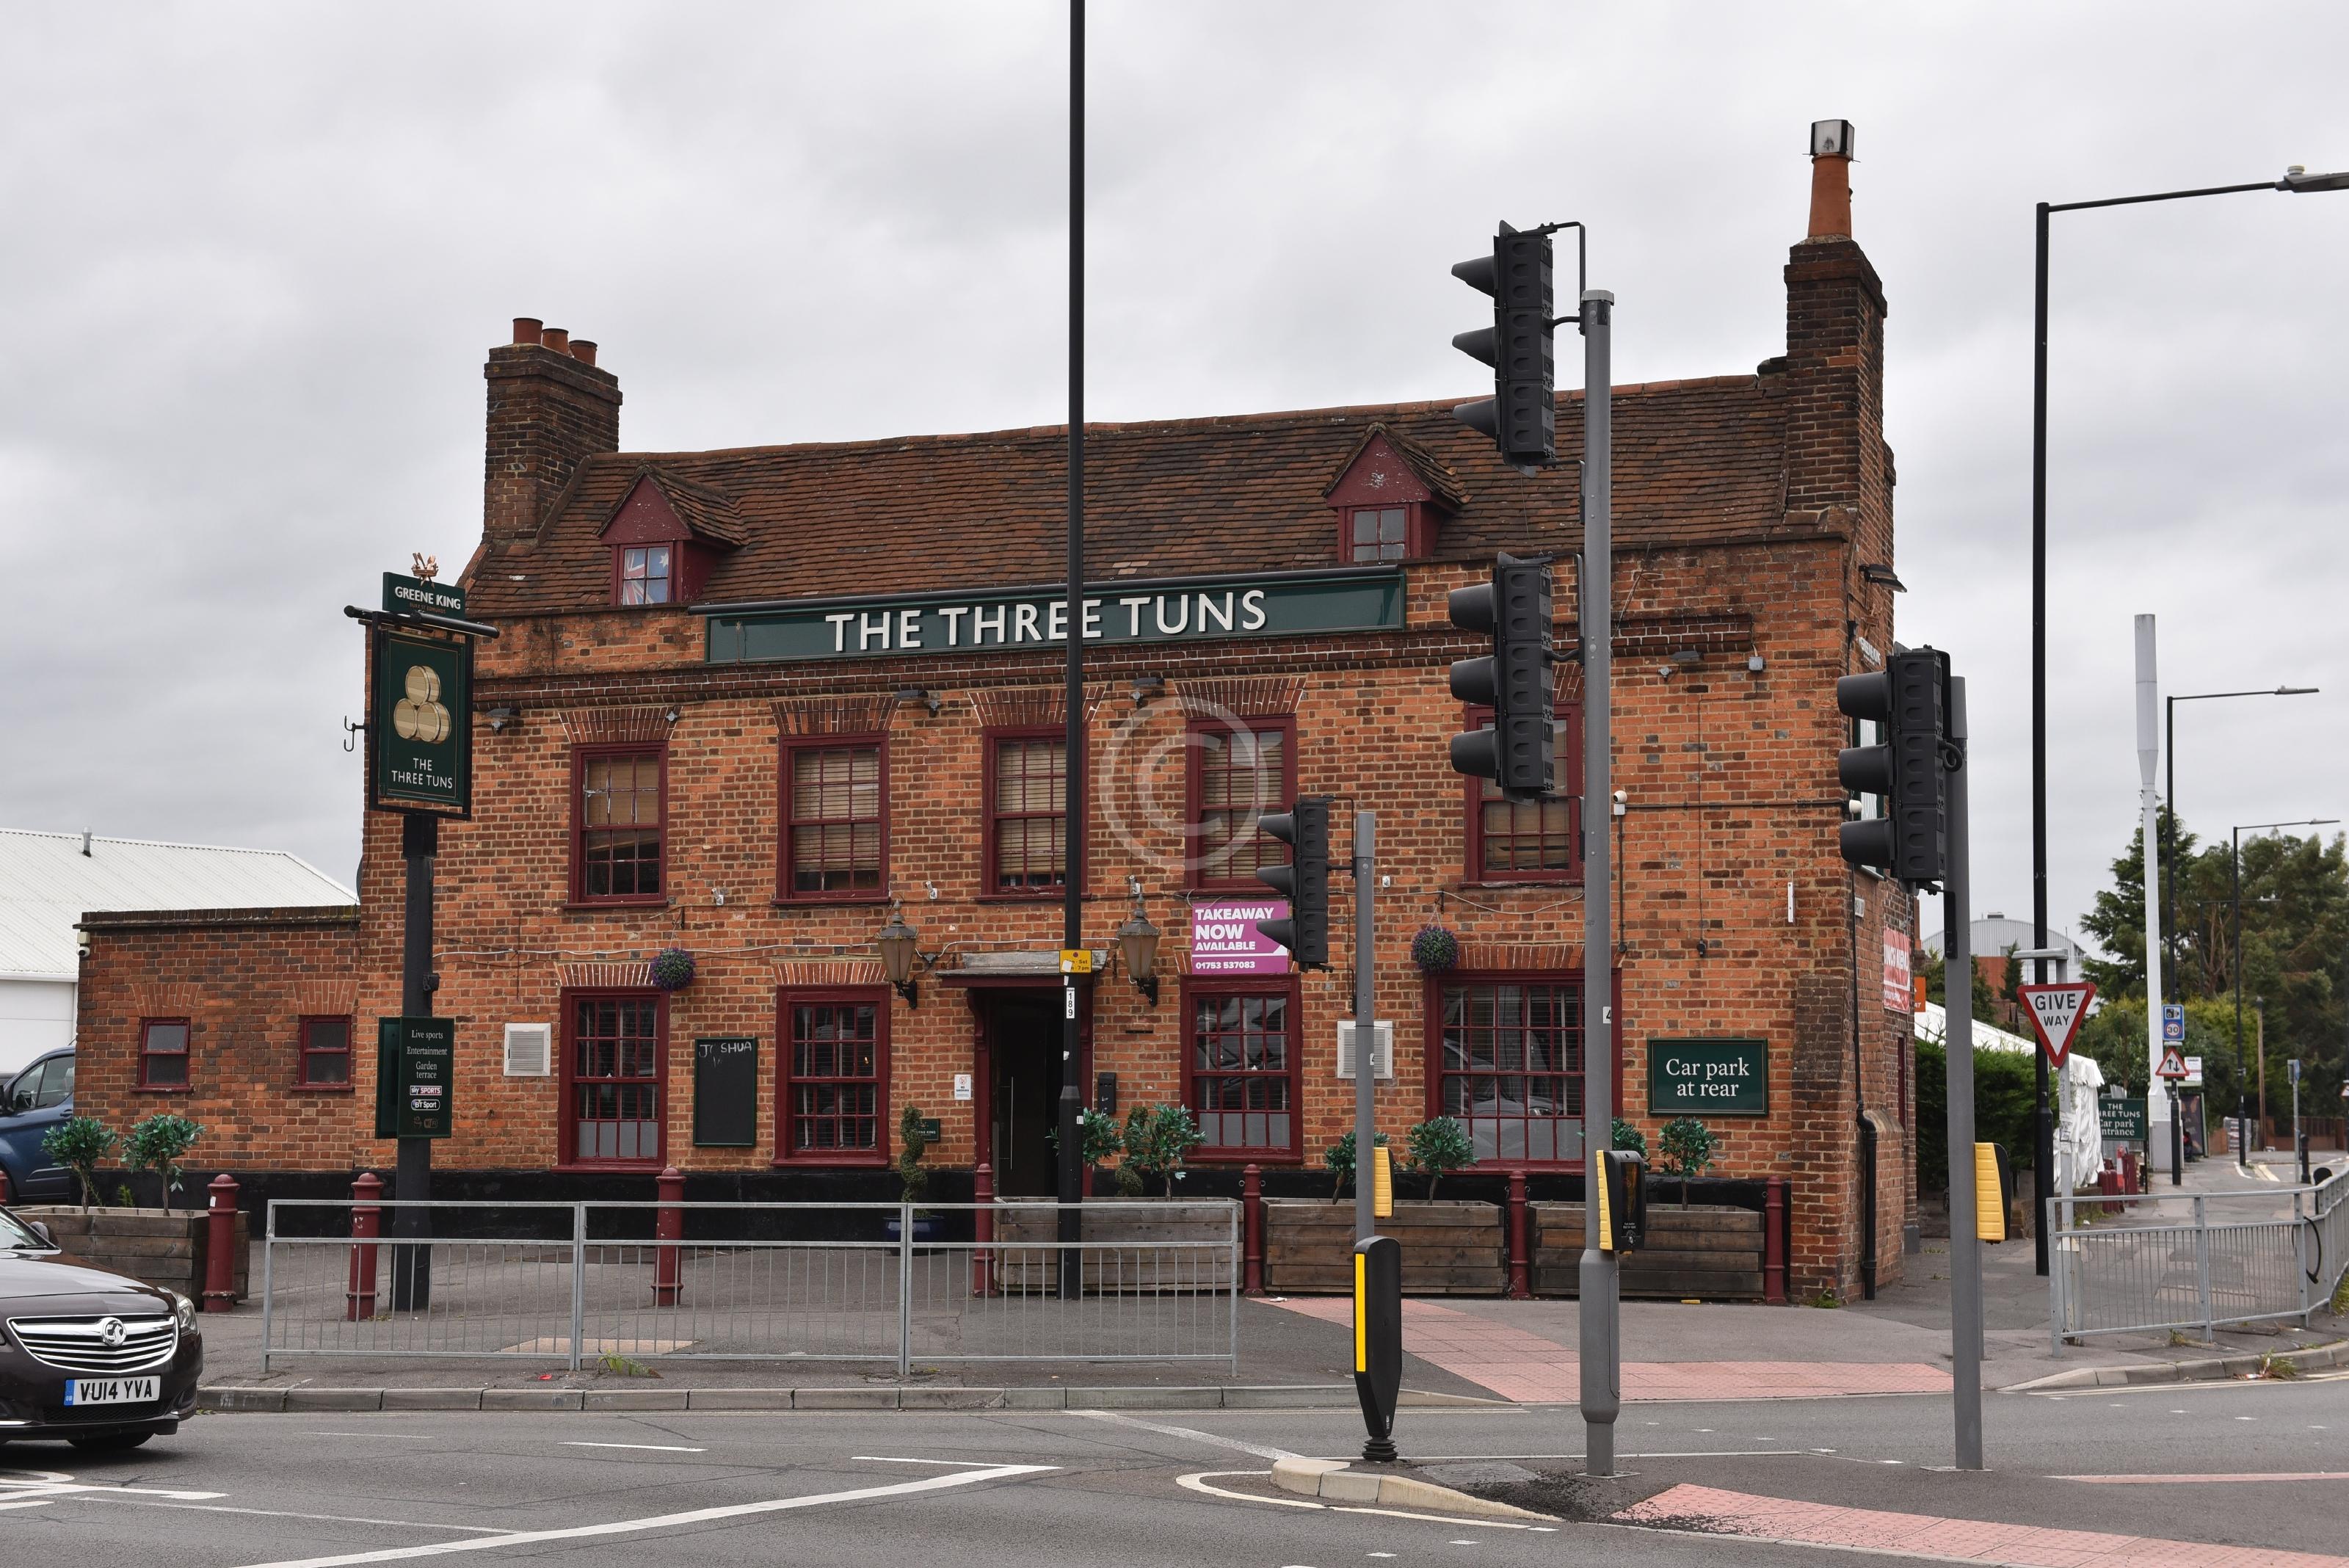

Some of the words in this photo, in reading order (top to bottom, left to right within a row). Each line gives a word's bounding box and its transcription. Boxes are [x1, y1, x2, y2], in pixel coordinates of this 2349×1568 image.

[395, 587, 434, 604] GREENE
[436, 595, 461, 610] KING
[826, 609, 922, 652] THE
[938, 600, 1102, 645] THREE
[1119, 590, 1268, 636] TUNS
[413, 758, 432, 771] THE
[391, 770, 424, 785] THREE
[426, 774, 453, 789] TUNS
[1195, 907, 1274, 921] TAKEAWAY
[1195, 924, 1244, 940] NOW
[1195, 941, 1255, 951] AVAILABLE
[2035, 993, 2077, 1010] GIVE
[2044, 1015, 2069, 1026] WAY
[411, 1029, 424, 1039] Live
[426, 1031, 443, 1041] sports
[407, 1046, 447, 1056] Entertainment
[415, 1061, 438, 1070] Garden
[1666, 1059, 1700, 1075] Car
[1706, 1057, 1749, 1080] park
[411, 1086, 419, 1095] sky
[1677, 1081, 1695, 1096] at
[1700, 1084, 1739, 1097] rear
[2114, 1119, 2135, 1129] park
[80, 1382, 118, 1401] VU14
[124, 1379, 152, 1399] YVA
